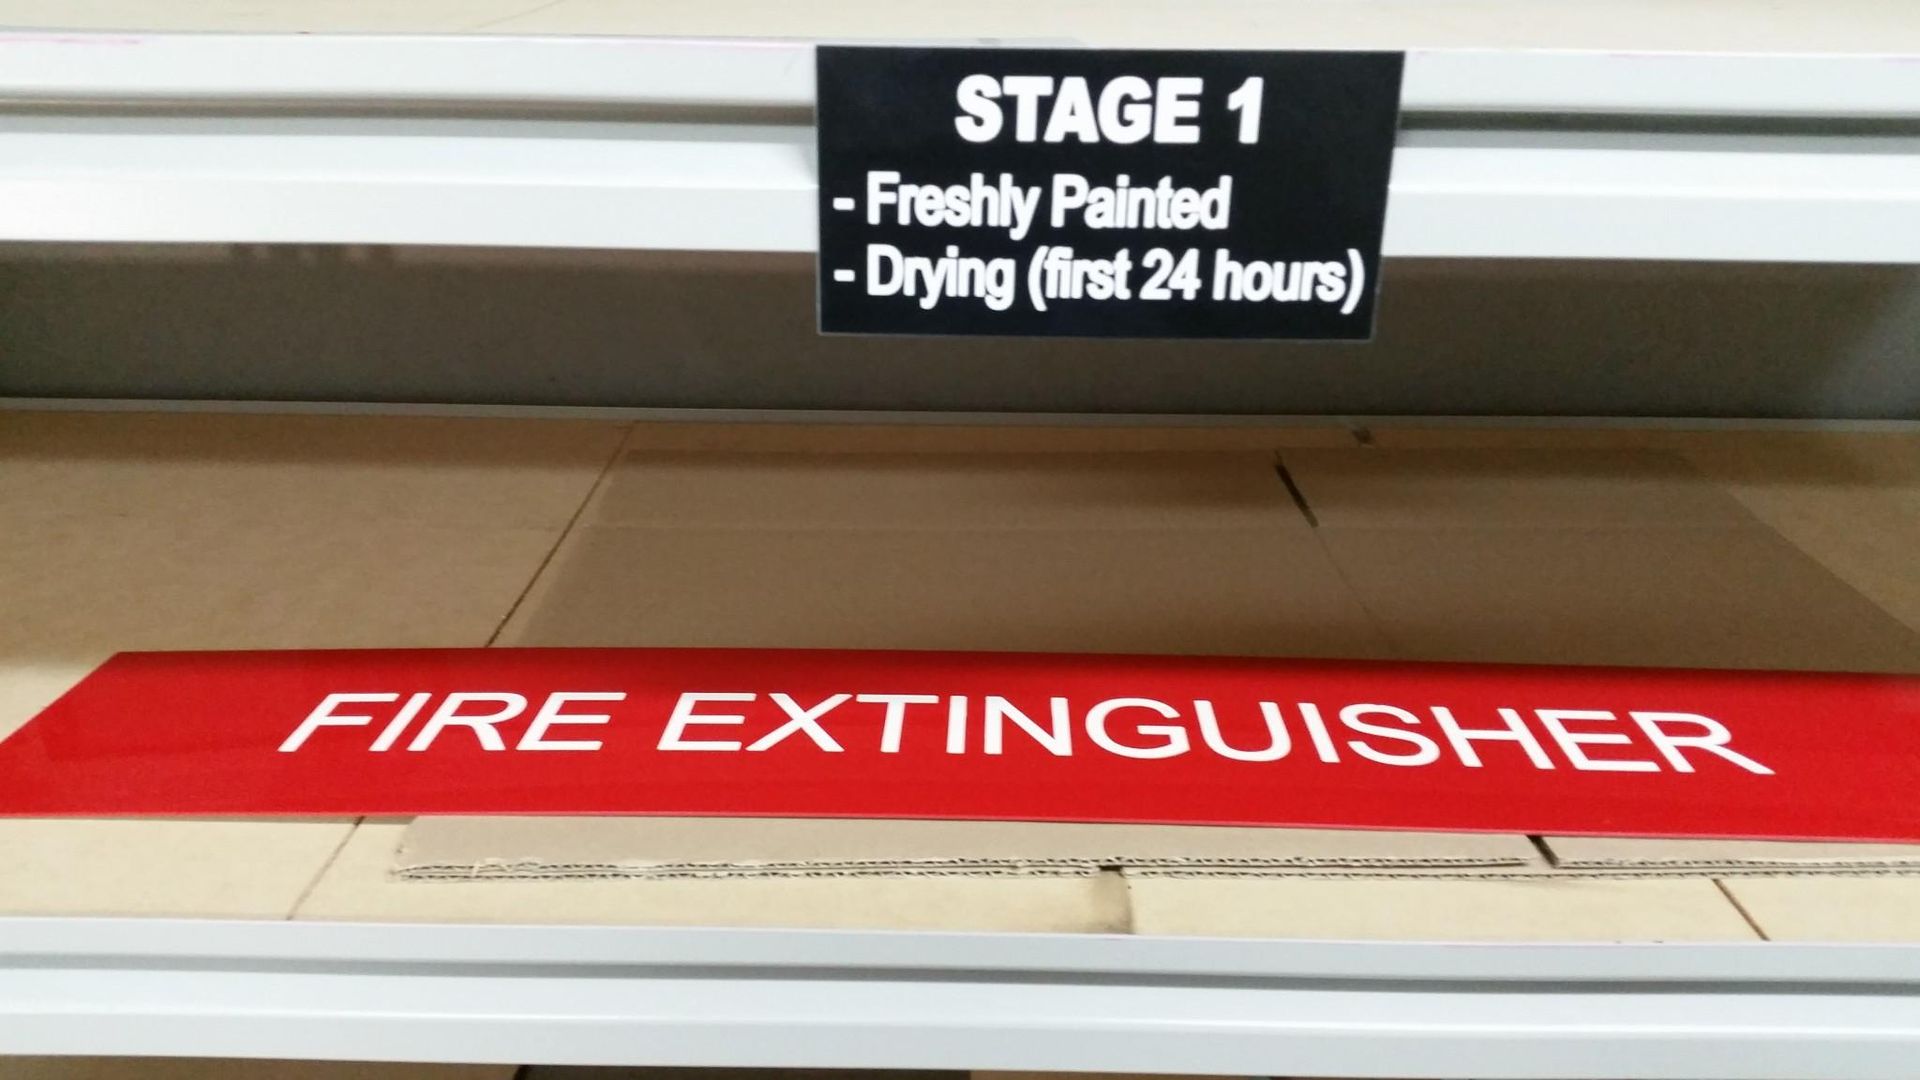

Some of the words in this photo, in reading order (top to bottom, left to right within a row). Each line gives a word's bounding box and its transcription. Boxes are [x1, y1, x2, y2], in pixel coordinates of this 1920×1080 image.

[954, 73, 1204, 145] STAGE
[1227, 75, 1264, 145] 1
[866, 170, 1042, 241] Freshly
[1050, 173, 1233, 231] Painted
[866, 243, 1016, 311] Drying
[1027, 245, 1133, 312] (first
[1138, 247, 1202, 302] 24
[1212, 247, 1365, 315] hours)
[277, 691, 627, 753] FIRE
[656, 691, 1775, 776] EXTINGUISHER
